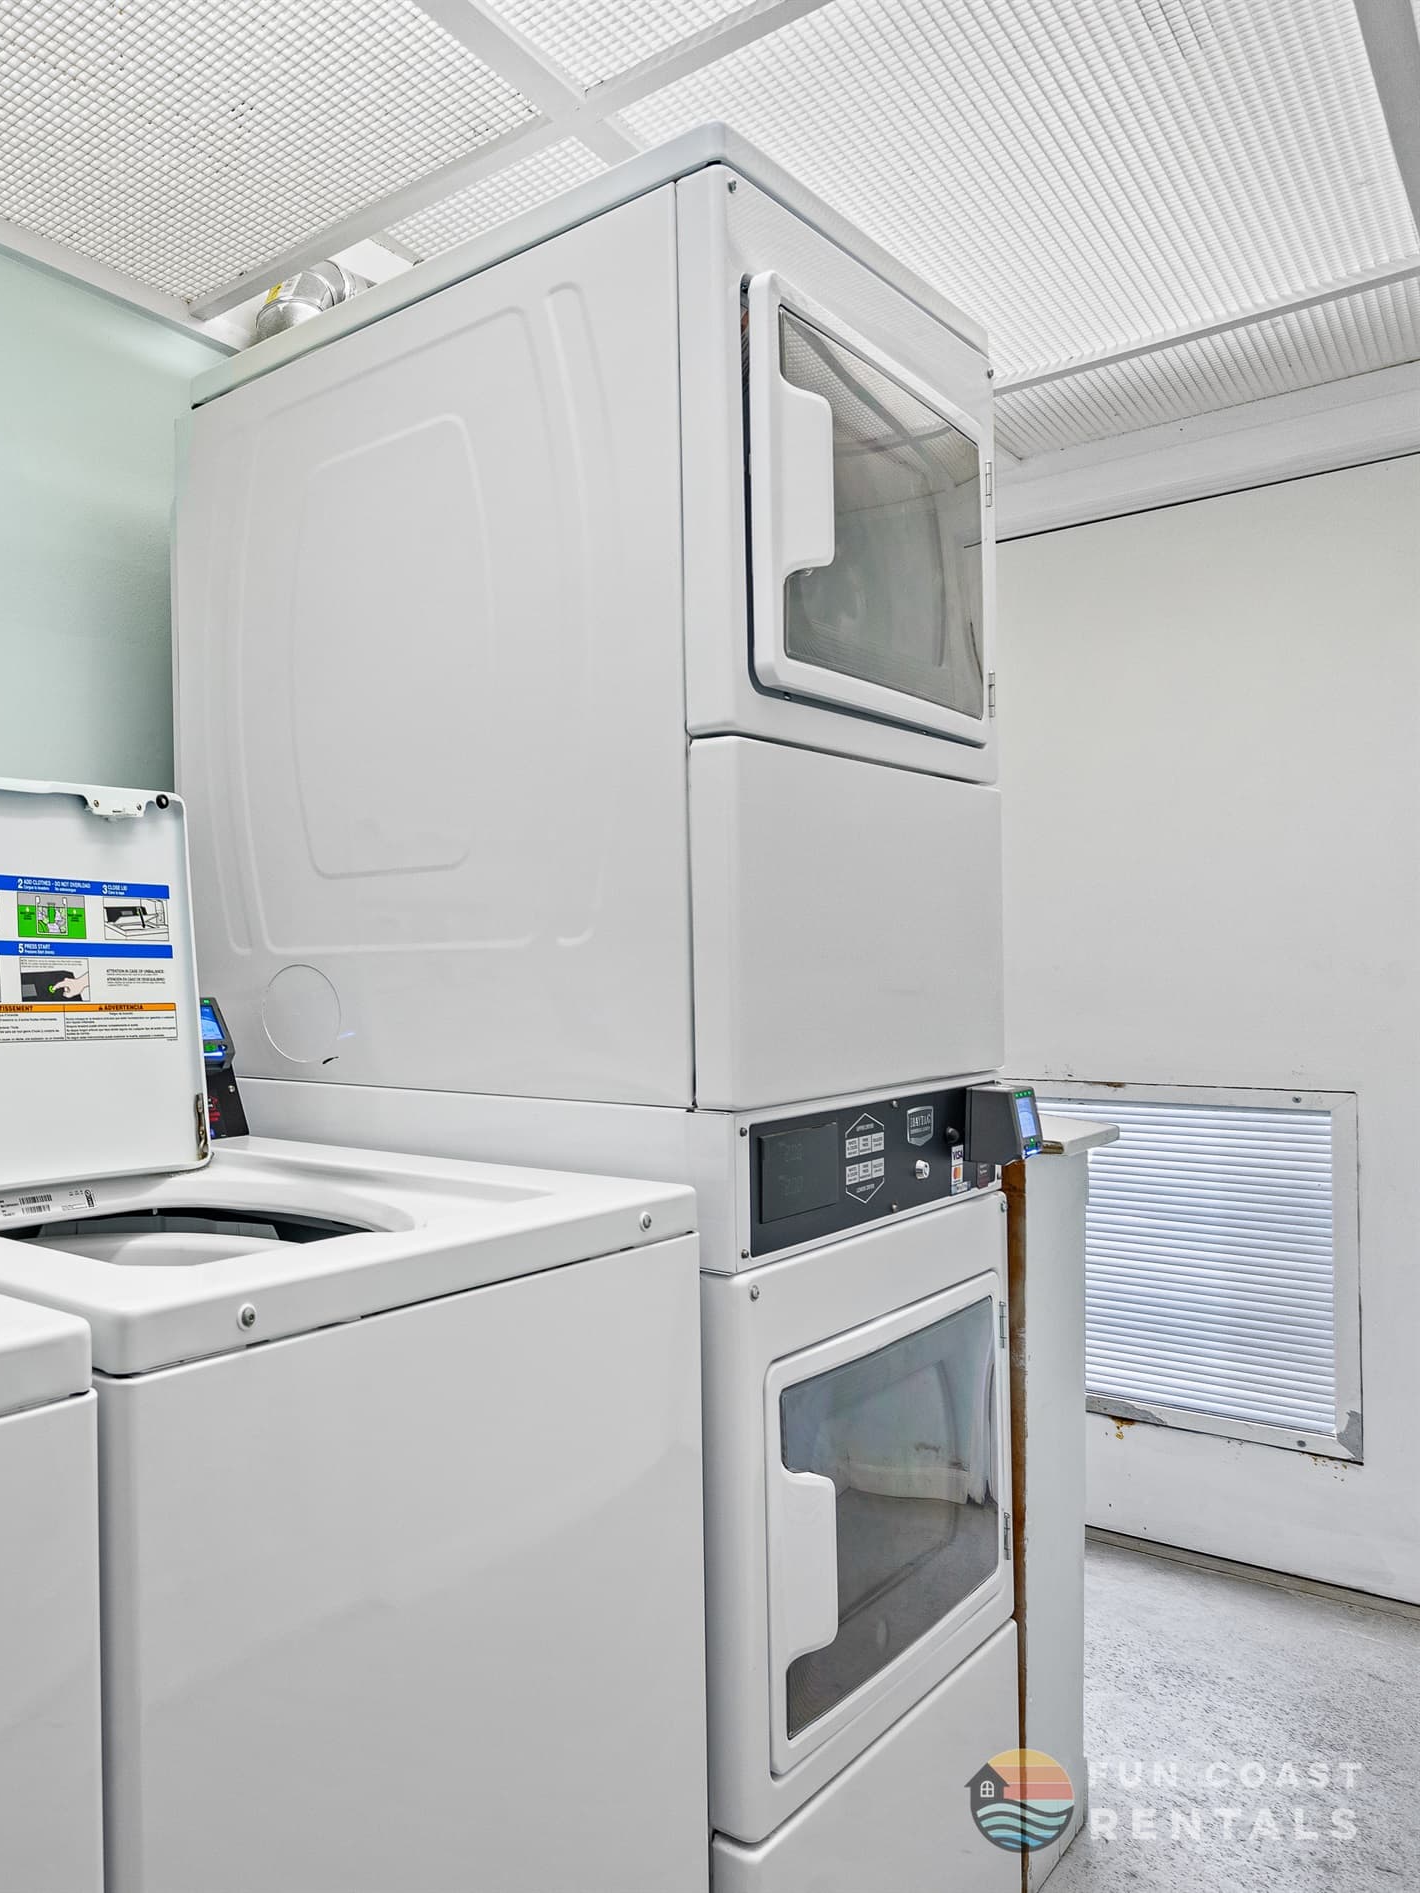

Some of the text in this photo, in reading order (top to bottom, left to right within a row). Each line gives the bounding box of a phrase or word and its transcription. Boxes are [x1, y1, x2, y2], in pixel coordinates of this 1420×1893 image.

[18, 878, 23, 889] 2
[102, 884, 108, 894] 3
[18, 943, 24, 953] 5
